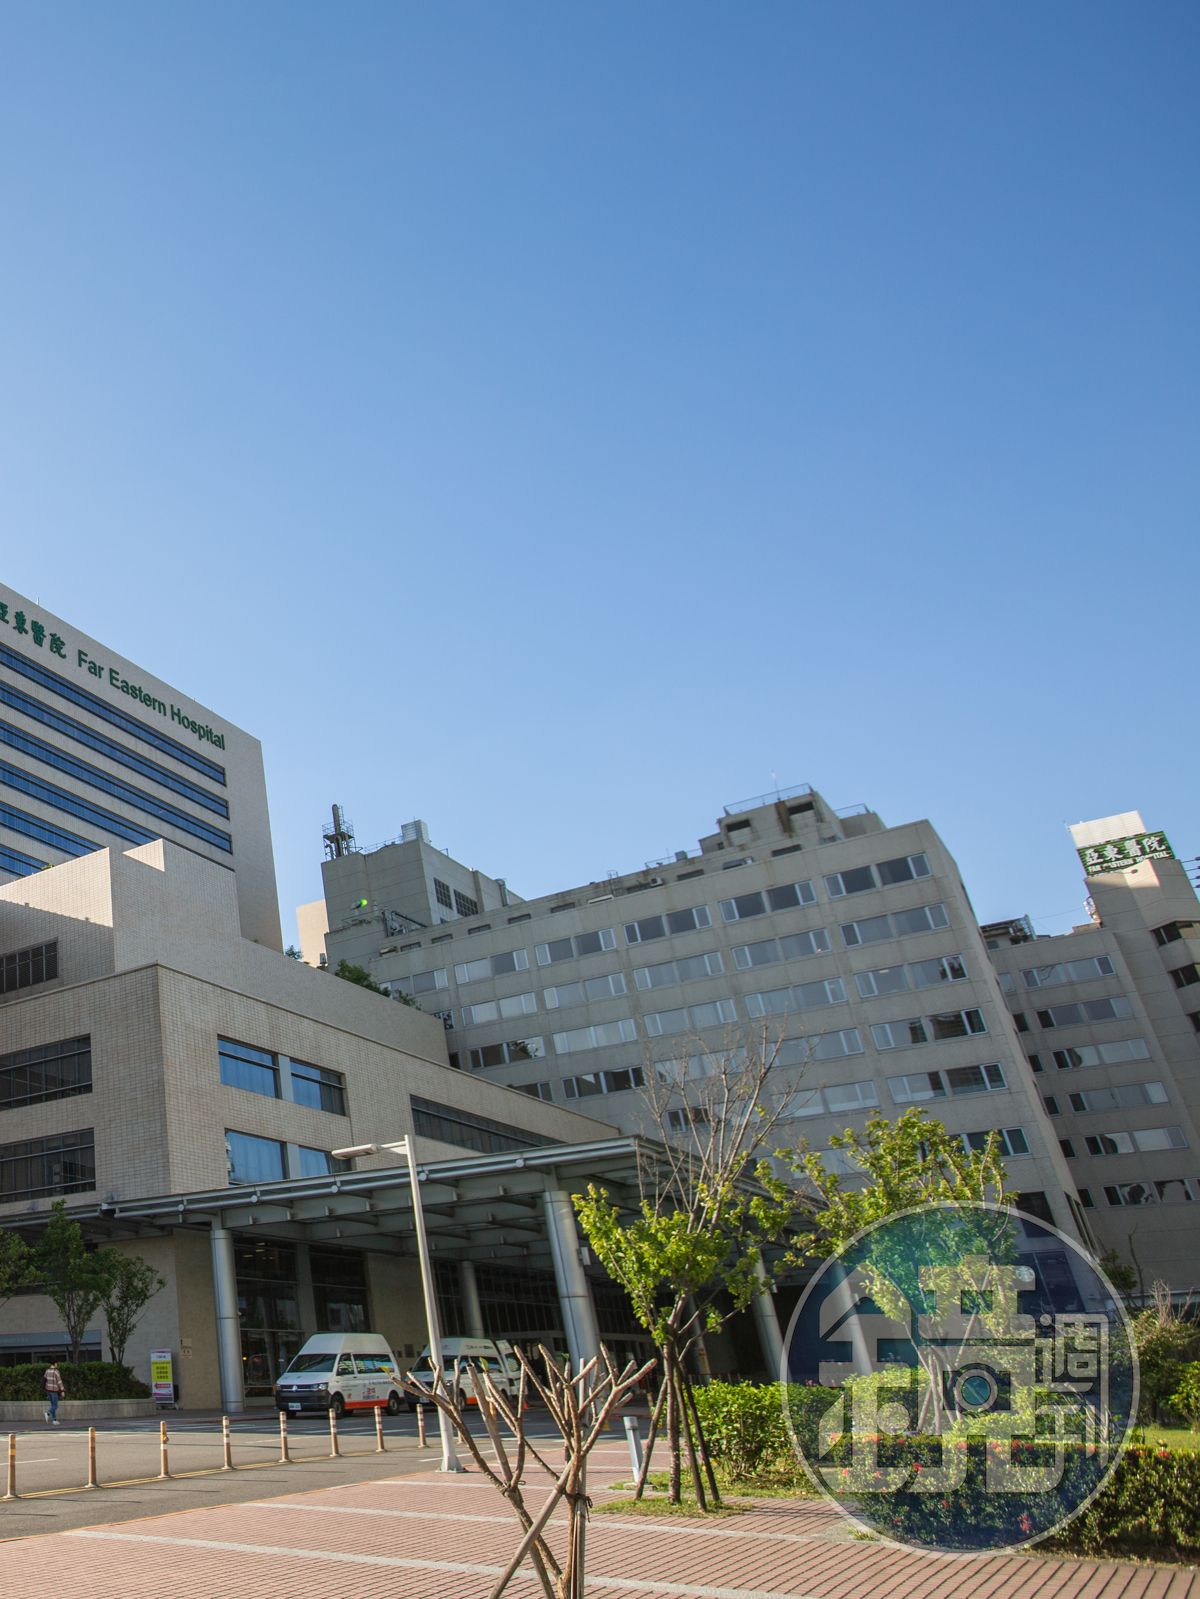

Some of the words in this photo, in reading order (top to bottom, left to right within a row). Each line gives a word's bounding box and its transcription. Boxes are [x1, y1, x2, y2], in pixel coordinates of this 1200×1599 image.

[77, 649, 104, 679] Far
[109, 667, 167, 717] Eastern
[170, 703, 225, 750] Hospital
[1085, 836, 1166, 865] 亞東醫院
